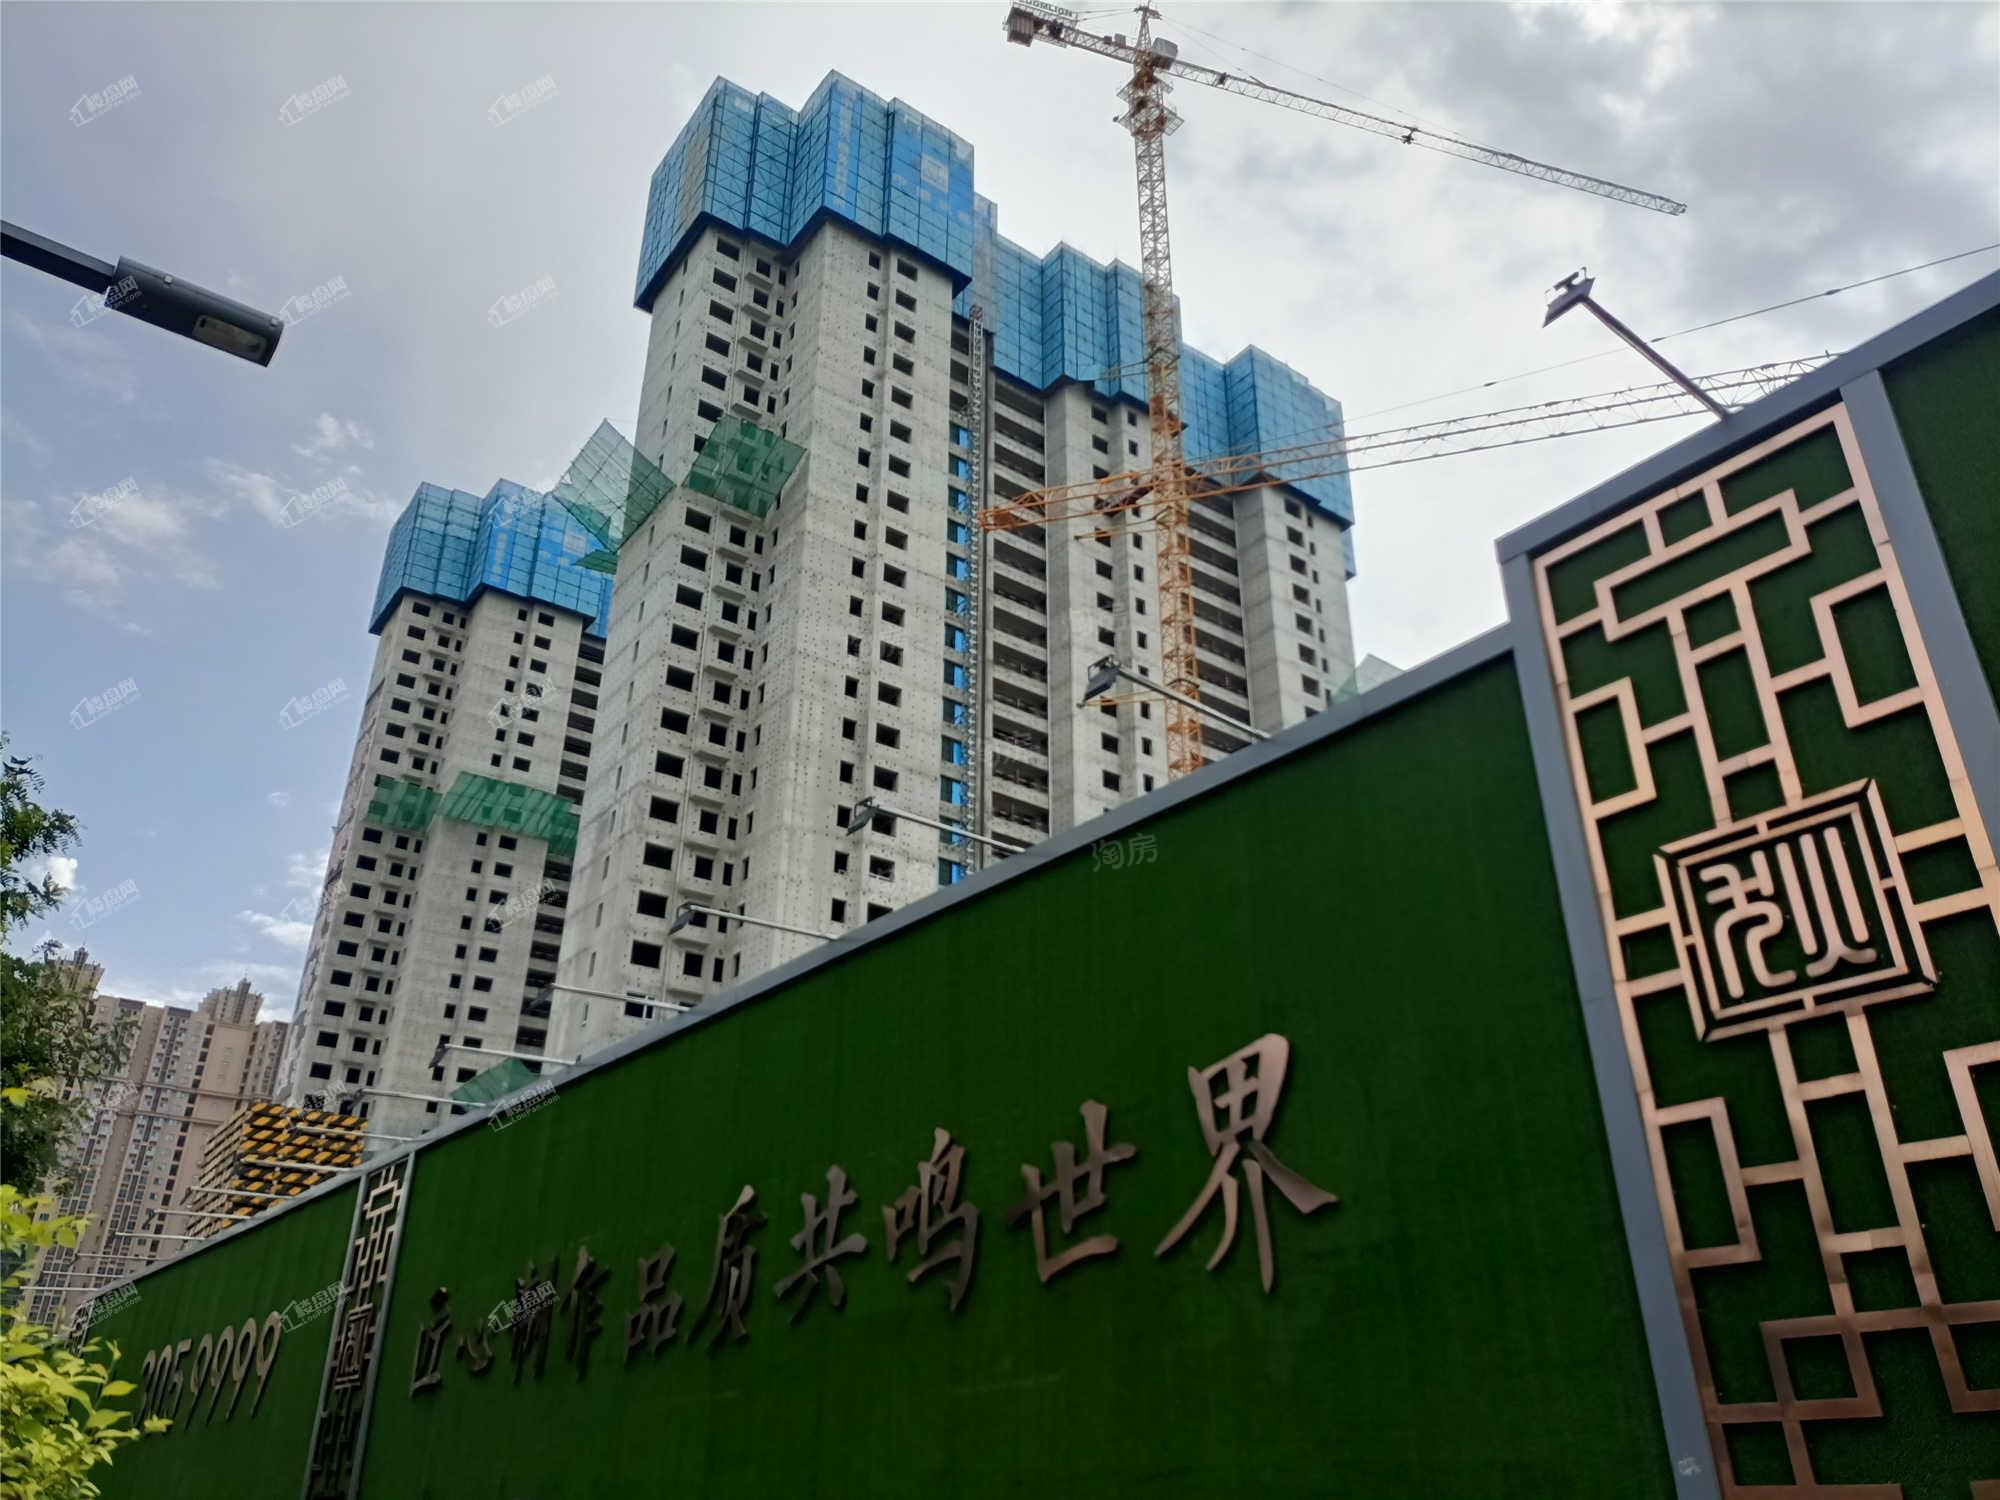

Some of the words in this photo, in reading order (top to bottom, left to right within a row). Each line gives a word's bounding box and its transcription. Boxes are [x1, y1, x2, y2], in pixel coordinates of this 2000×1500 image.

[409, 1033, 1339, 1399] 匠心制作品质共鸣世界
